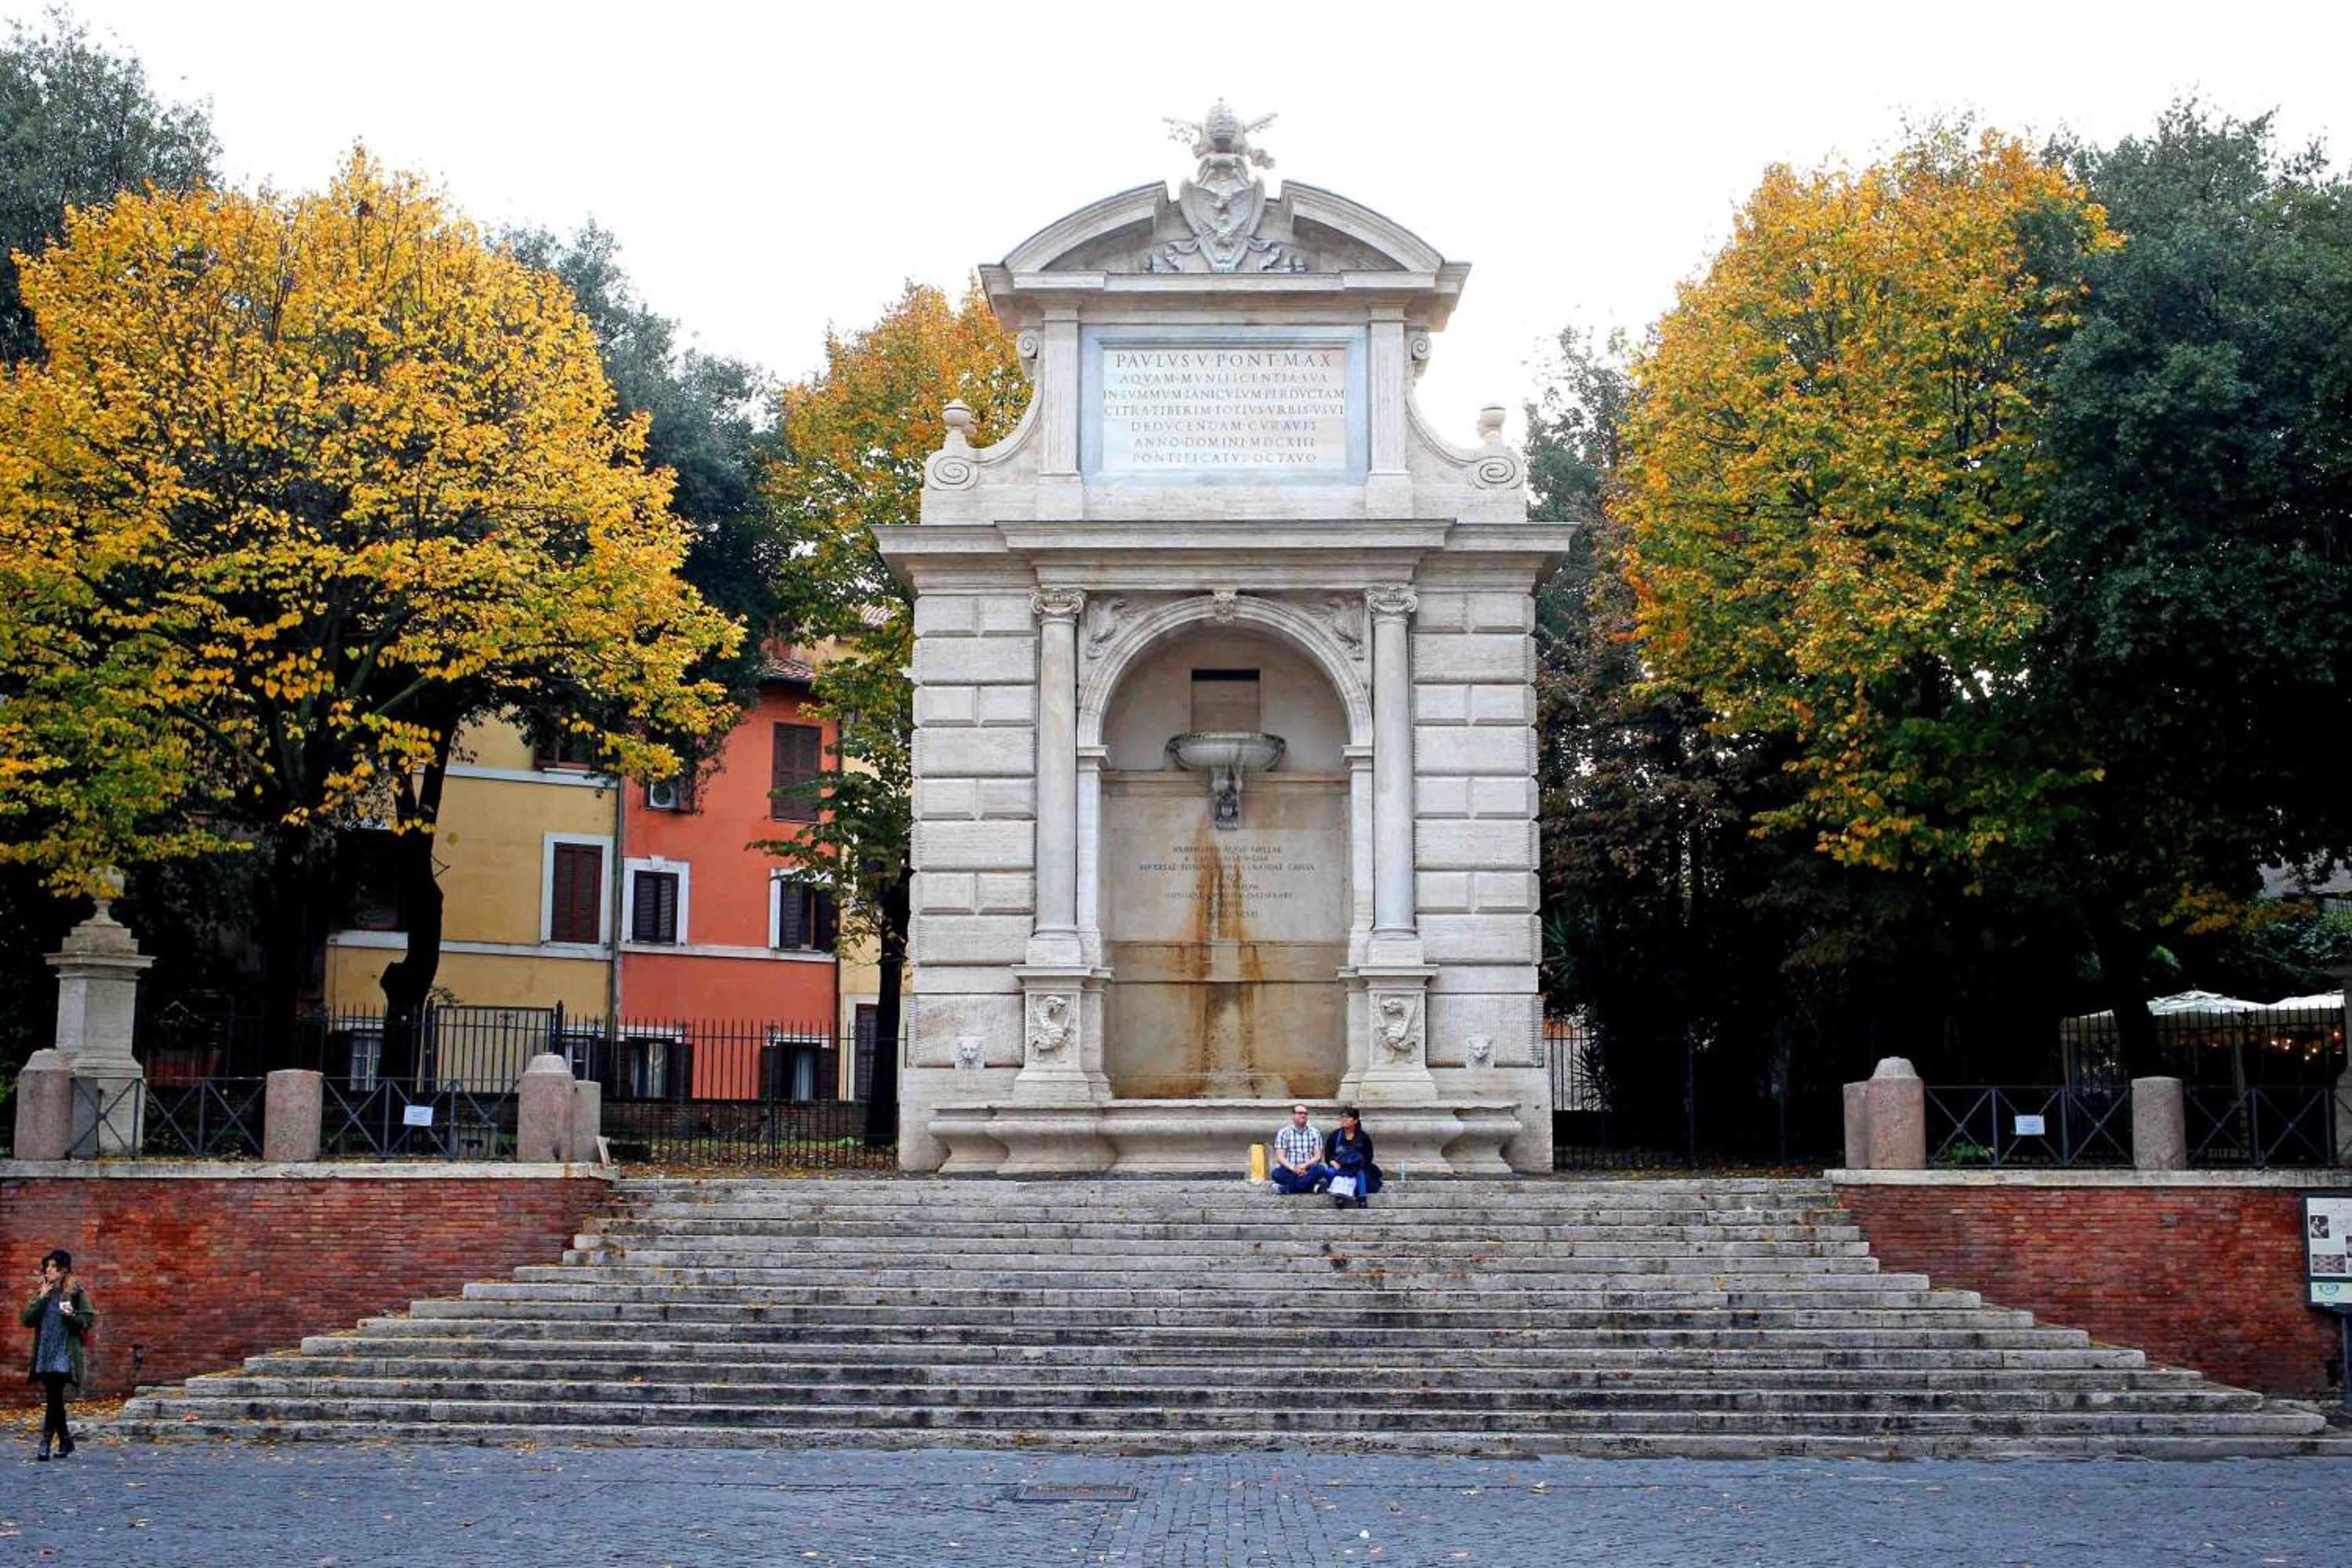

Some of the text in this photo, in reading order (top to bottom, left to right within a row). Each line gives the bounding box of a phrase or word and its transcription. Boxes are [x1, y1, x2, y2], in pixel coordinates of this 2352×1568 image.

[1116, 354, 1190, 368] PAVLVS
[1216, 354, 1280, 368] PONT
[1283, 354, 1331, 368] MAX
[1119, 373, 1174, 386] AQVAM
[1103, 389, 1117, 400] IN
[1105, 404, 1344, 416] CITRA TIBERIM TOTIVS VRBIS VSVI
[1131, 421, 1241, 432] DEDVCENDAM
[1134, 437, 1179, 448] ANNO
[1185, 437, 1245, 448] DOMINI
[1254, 452, 1317, 463] OCTAVO
